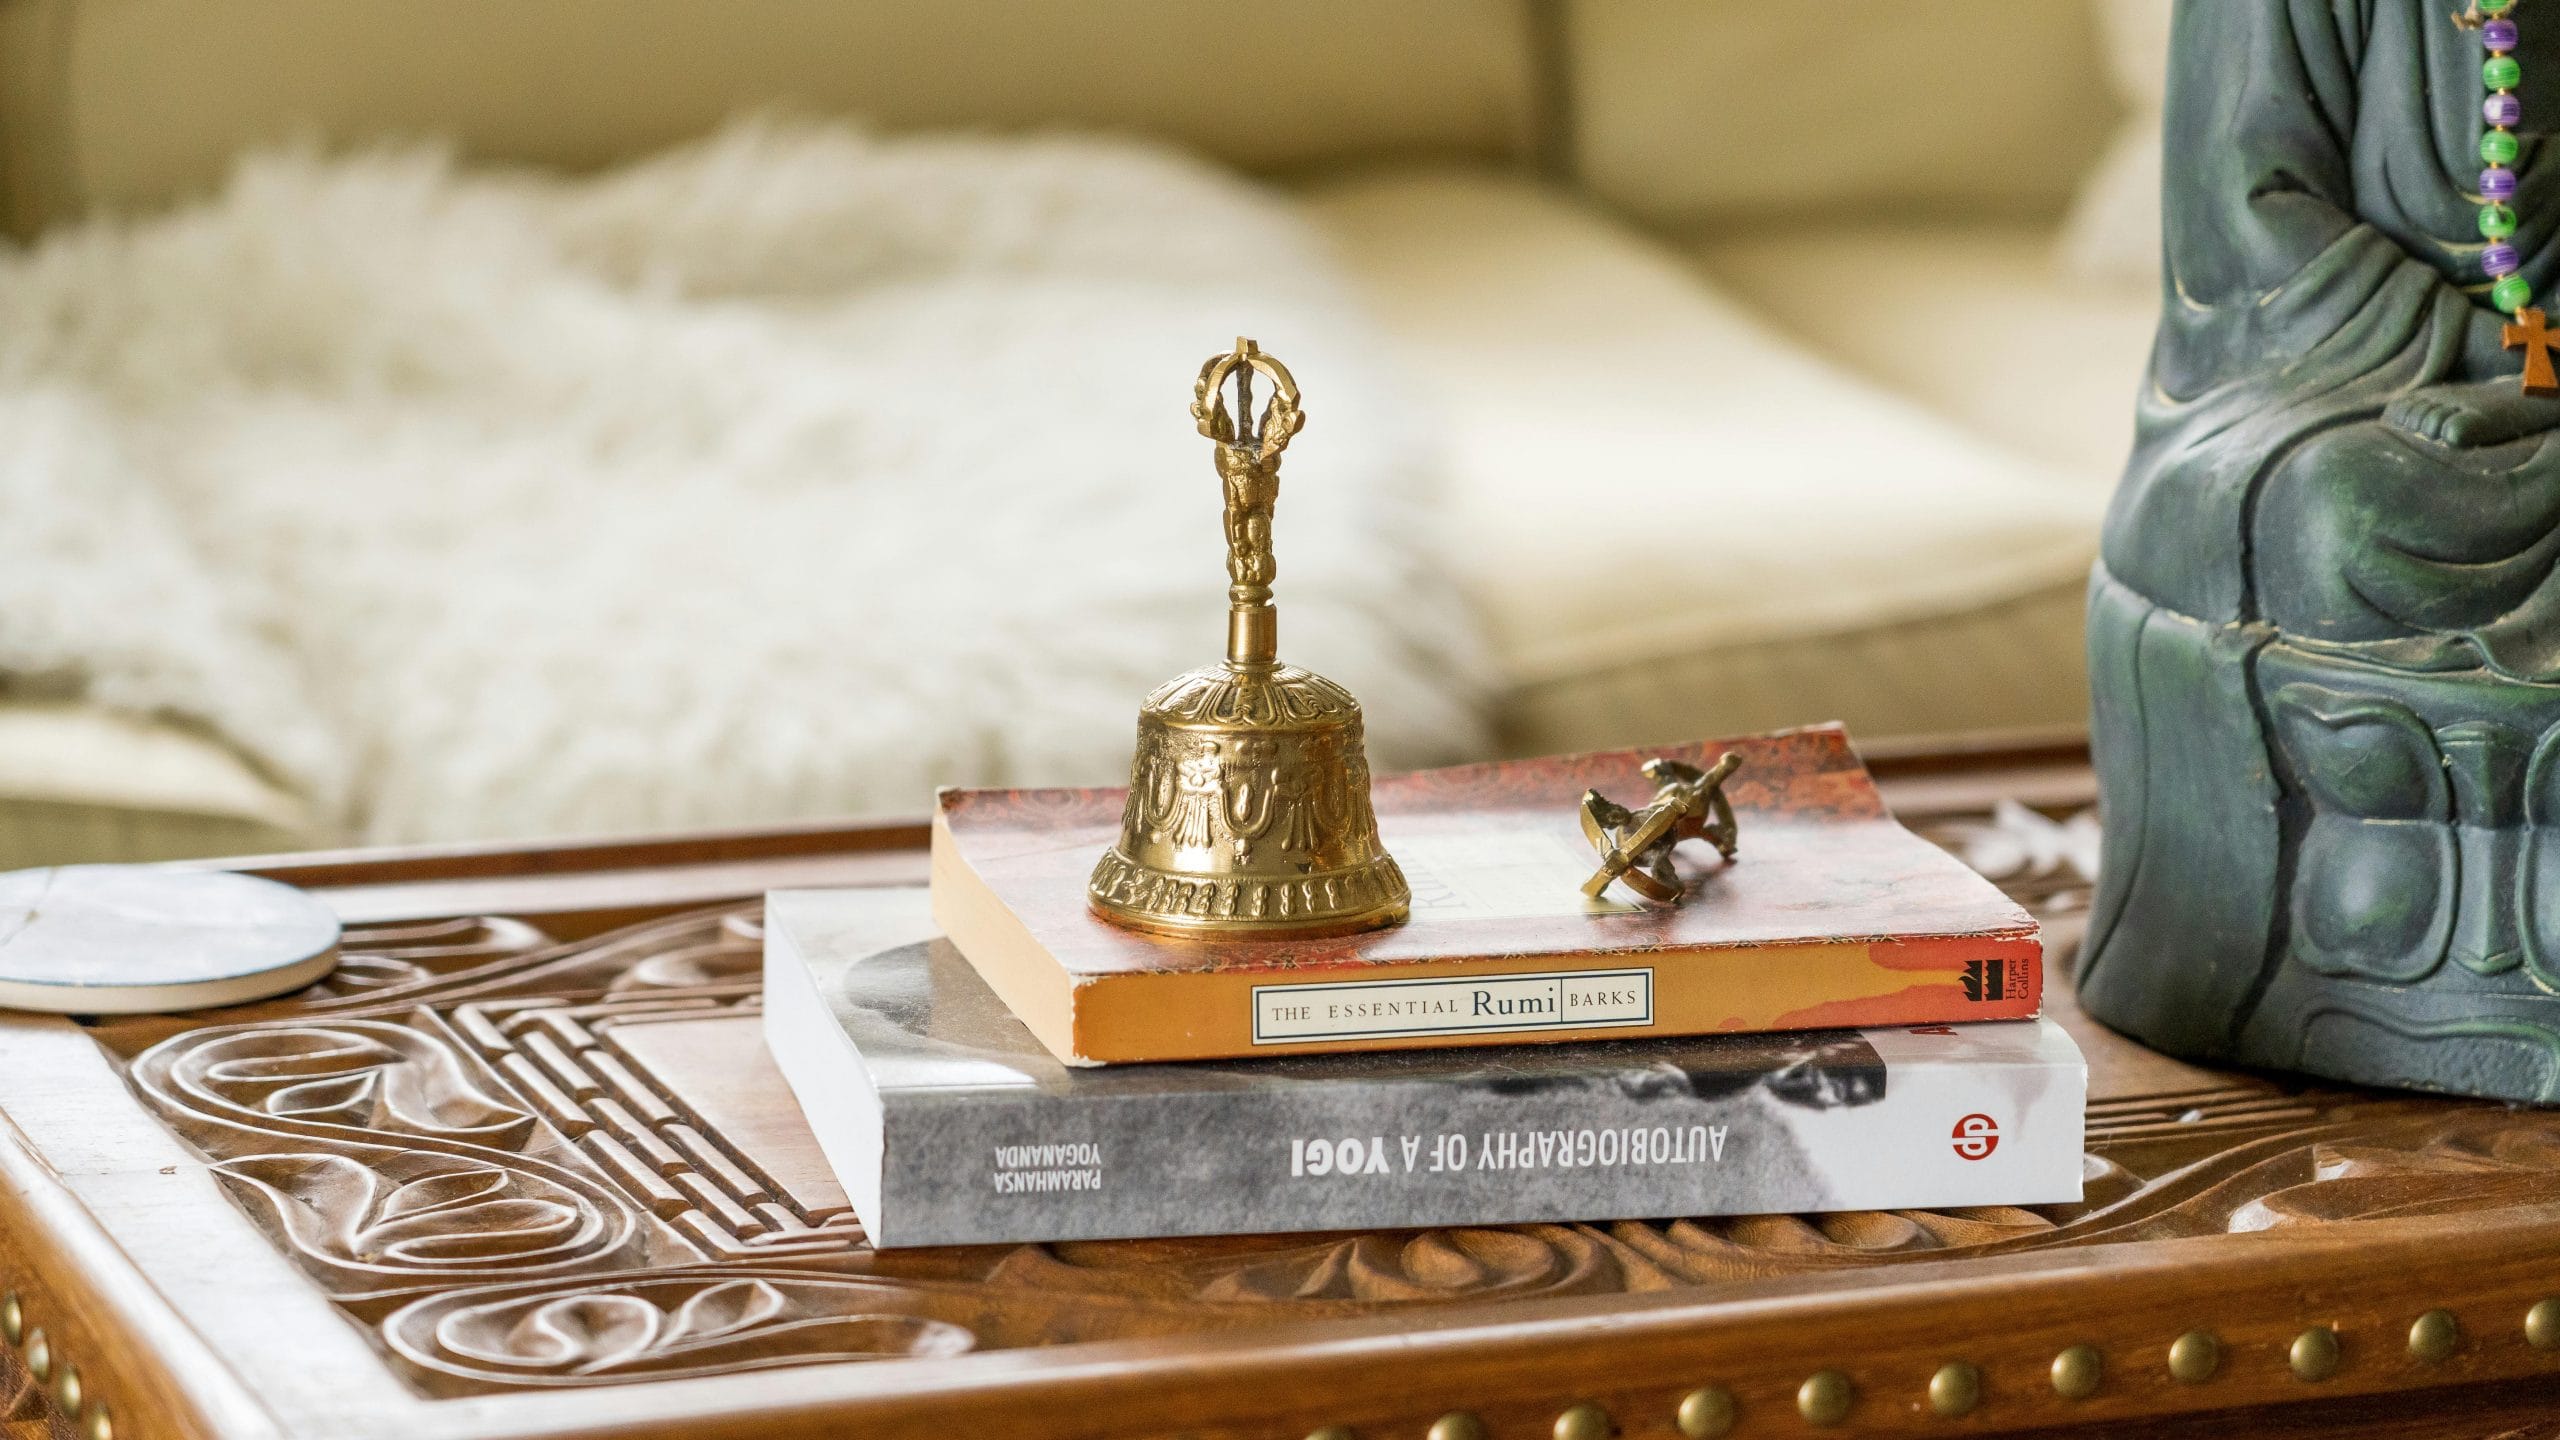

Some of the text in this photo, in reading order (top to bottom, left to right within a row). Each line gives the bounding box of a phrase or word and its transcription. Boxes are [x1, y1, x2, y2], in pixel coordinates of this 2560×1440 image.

[2005, 958, 2020, 1000] Harper
[2017, 958, 2029, 1000] Collins
[1272, 986, 1556, 1021] THE ESSENTIAL Rumi
[1570, 989, 1637, 1008] BARKS
[994, 1142, 1102, 1168] YOGANANDA
[1291, 1125, 1729, 1177] AUTOBIOGRAPHY OF A YOGI
[994, 1168, 1102, 1193] PARAMHANSA
